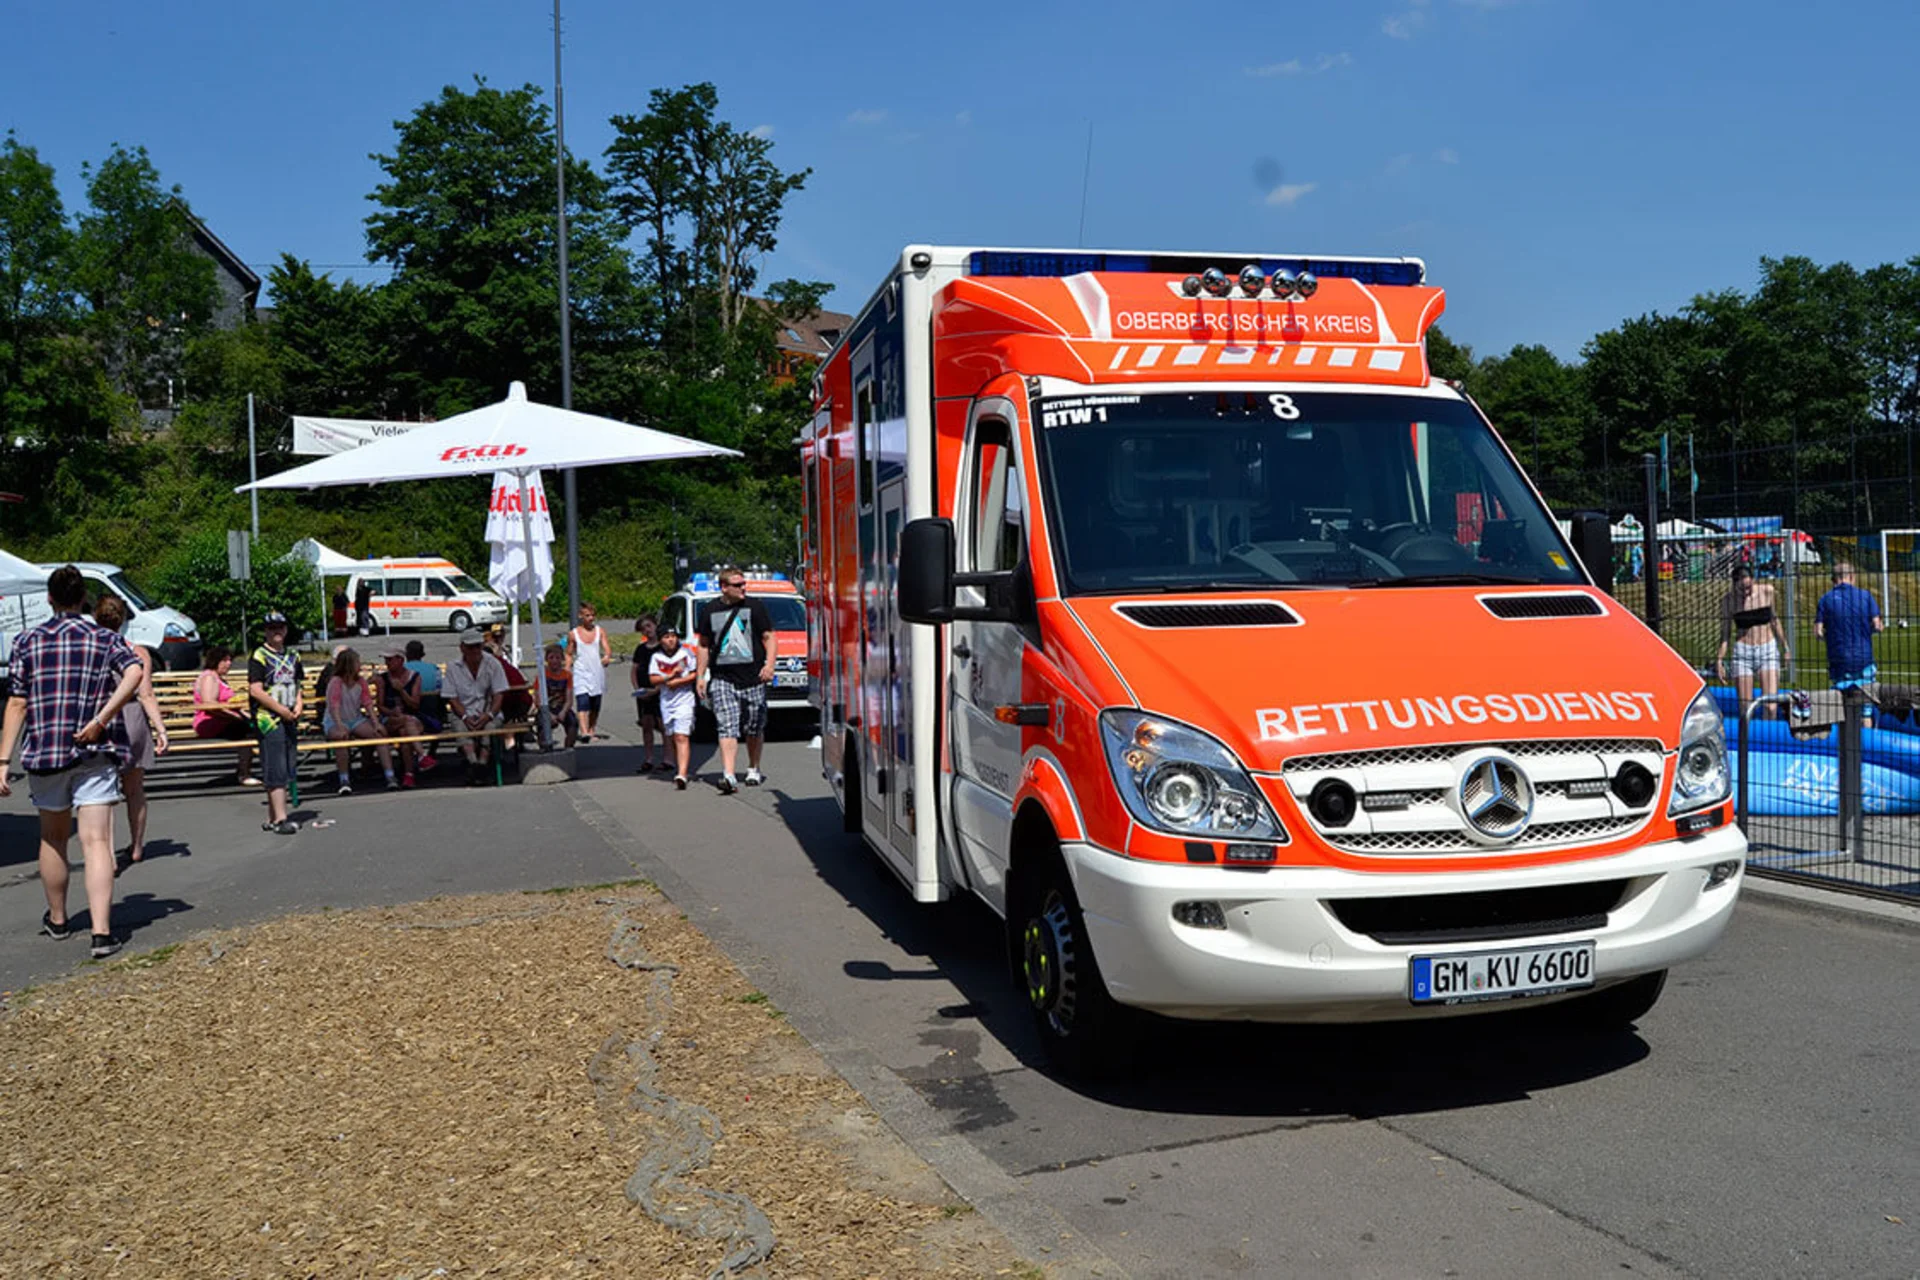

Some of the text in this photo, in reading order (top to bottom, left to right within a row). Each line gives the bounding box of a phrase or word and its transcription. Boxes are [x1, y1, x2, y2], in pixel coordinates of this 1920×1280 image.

[1117, 311, 1373, 334] OBERBERGISCHER KREIS
[1043, 406, 1107, 428] RTW 1
[1268, 394, 1300, 419] 8
[1054, 697, 1065, 745] 8
[1255, 691, 1661, 741] RETTUNGSDIENST
[1433, 961, 1468, 993] GM
[1487, 956, 1520, 988] KV
[1527, 949, 1590, 984] 6600
